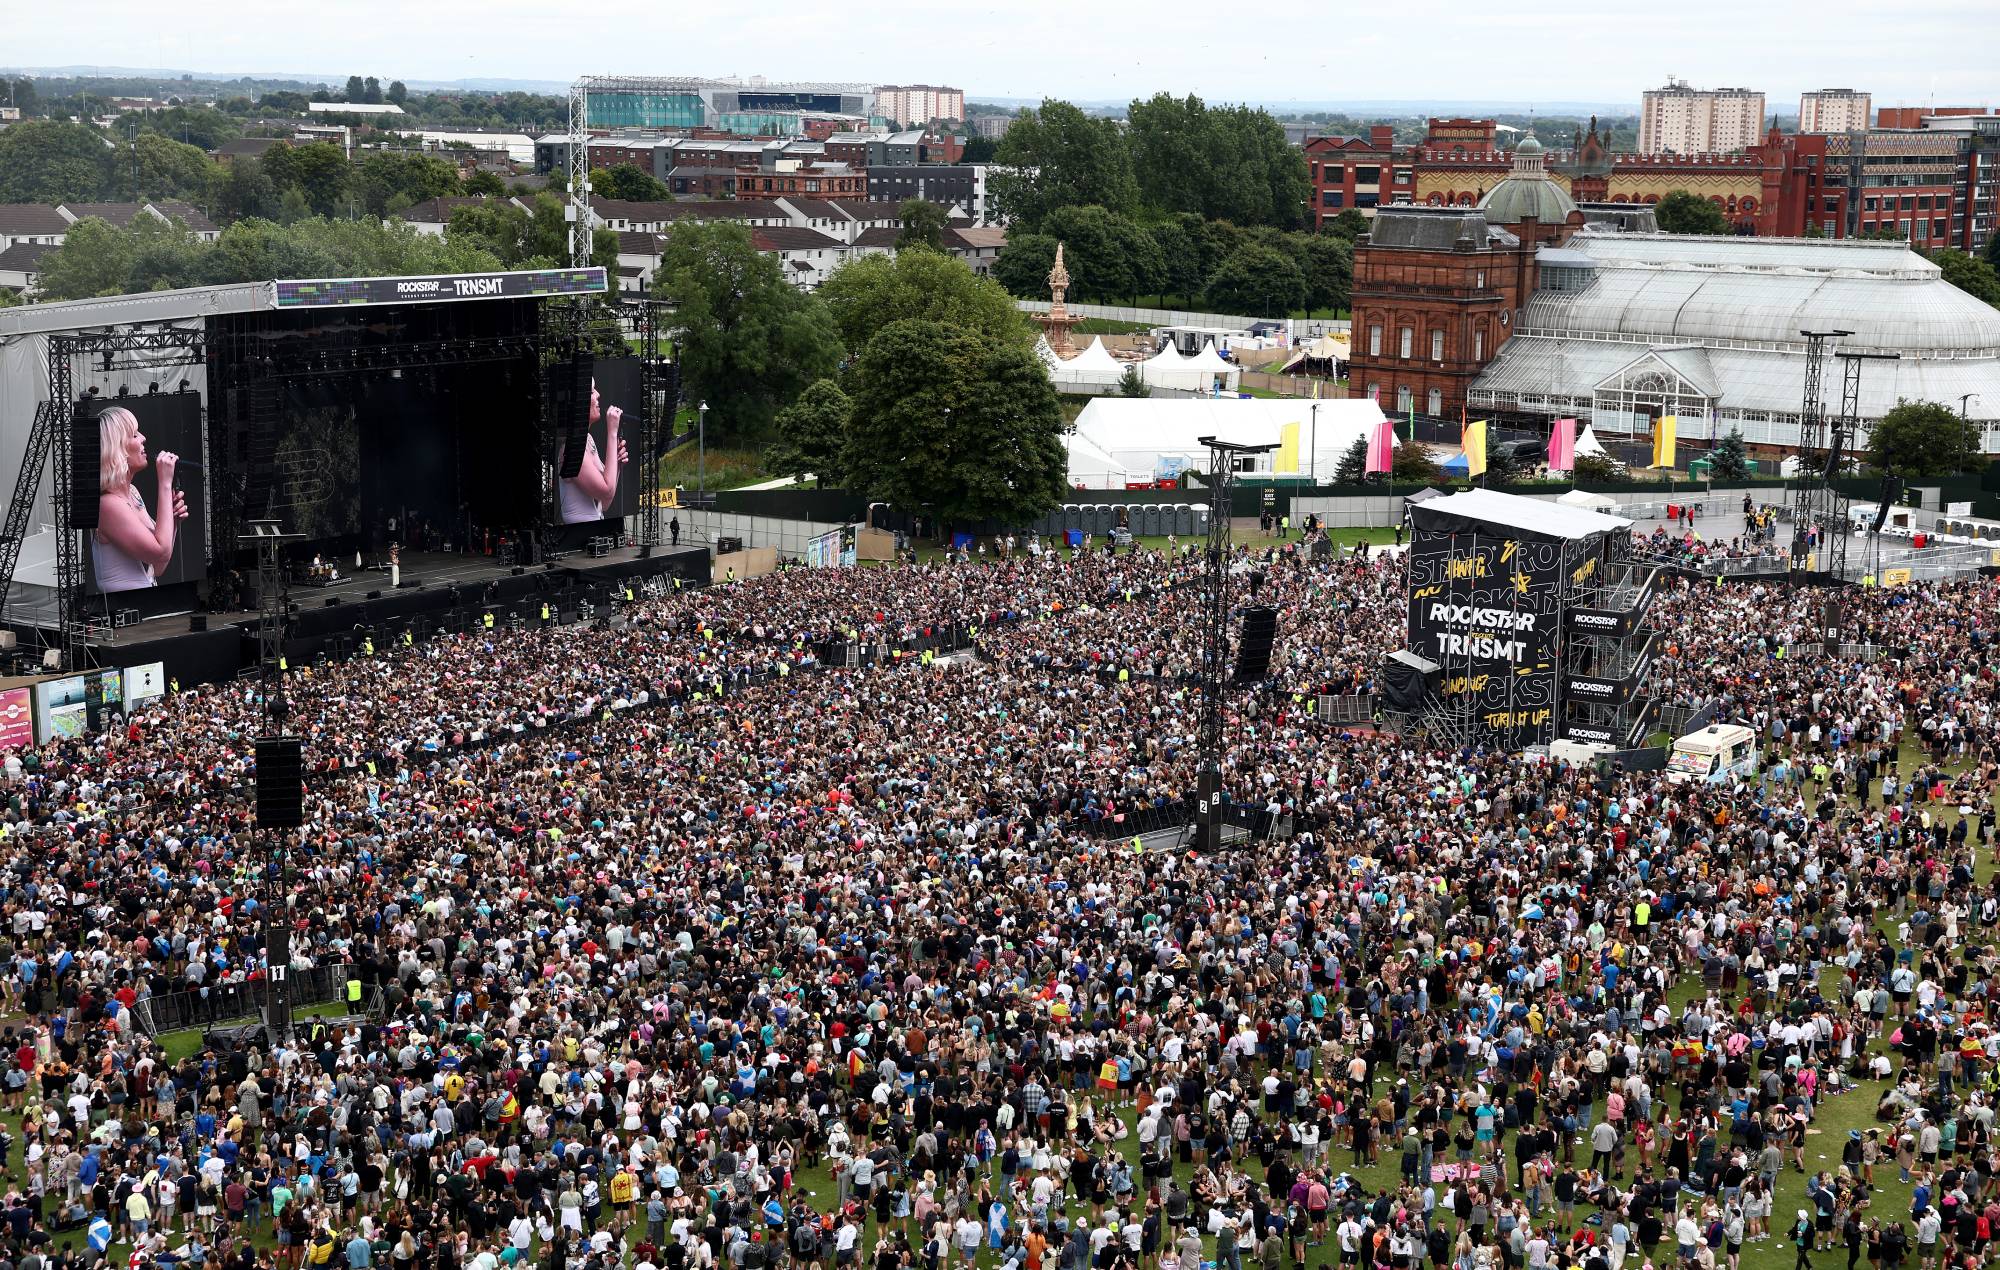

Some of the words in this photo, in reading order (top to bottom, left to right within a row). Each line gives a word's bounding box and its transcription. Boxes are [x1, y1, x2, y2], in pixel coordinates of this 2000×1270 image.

[397, 281, 440, 293] ROCKSTAR
[453, 278, 504, 296] TRNSMT
[1429, 603, 1535, 632] ROCKSTAR
[1574, 614, 1618, 626] ROCKSTAR
[1436, 632, 1527, 663] TRNSMT
[1570, 681, 1614, 694] ROCKSTAR
[1568, 727, 1611, 741] ROCKSTAR
